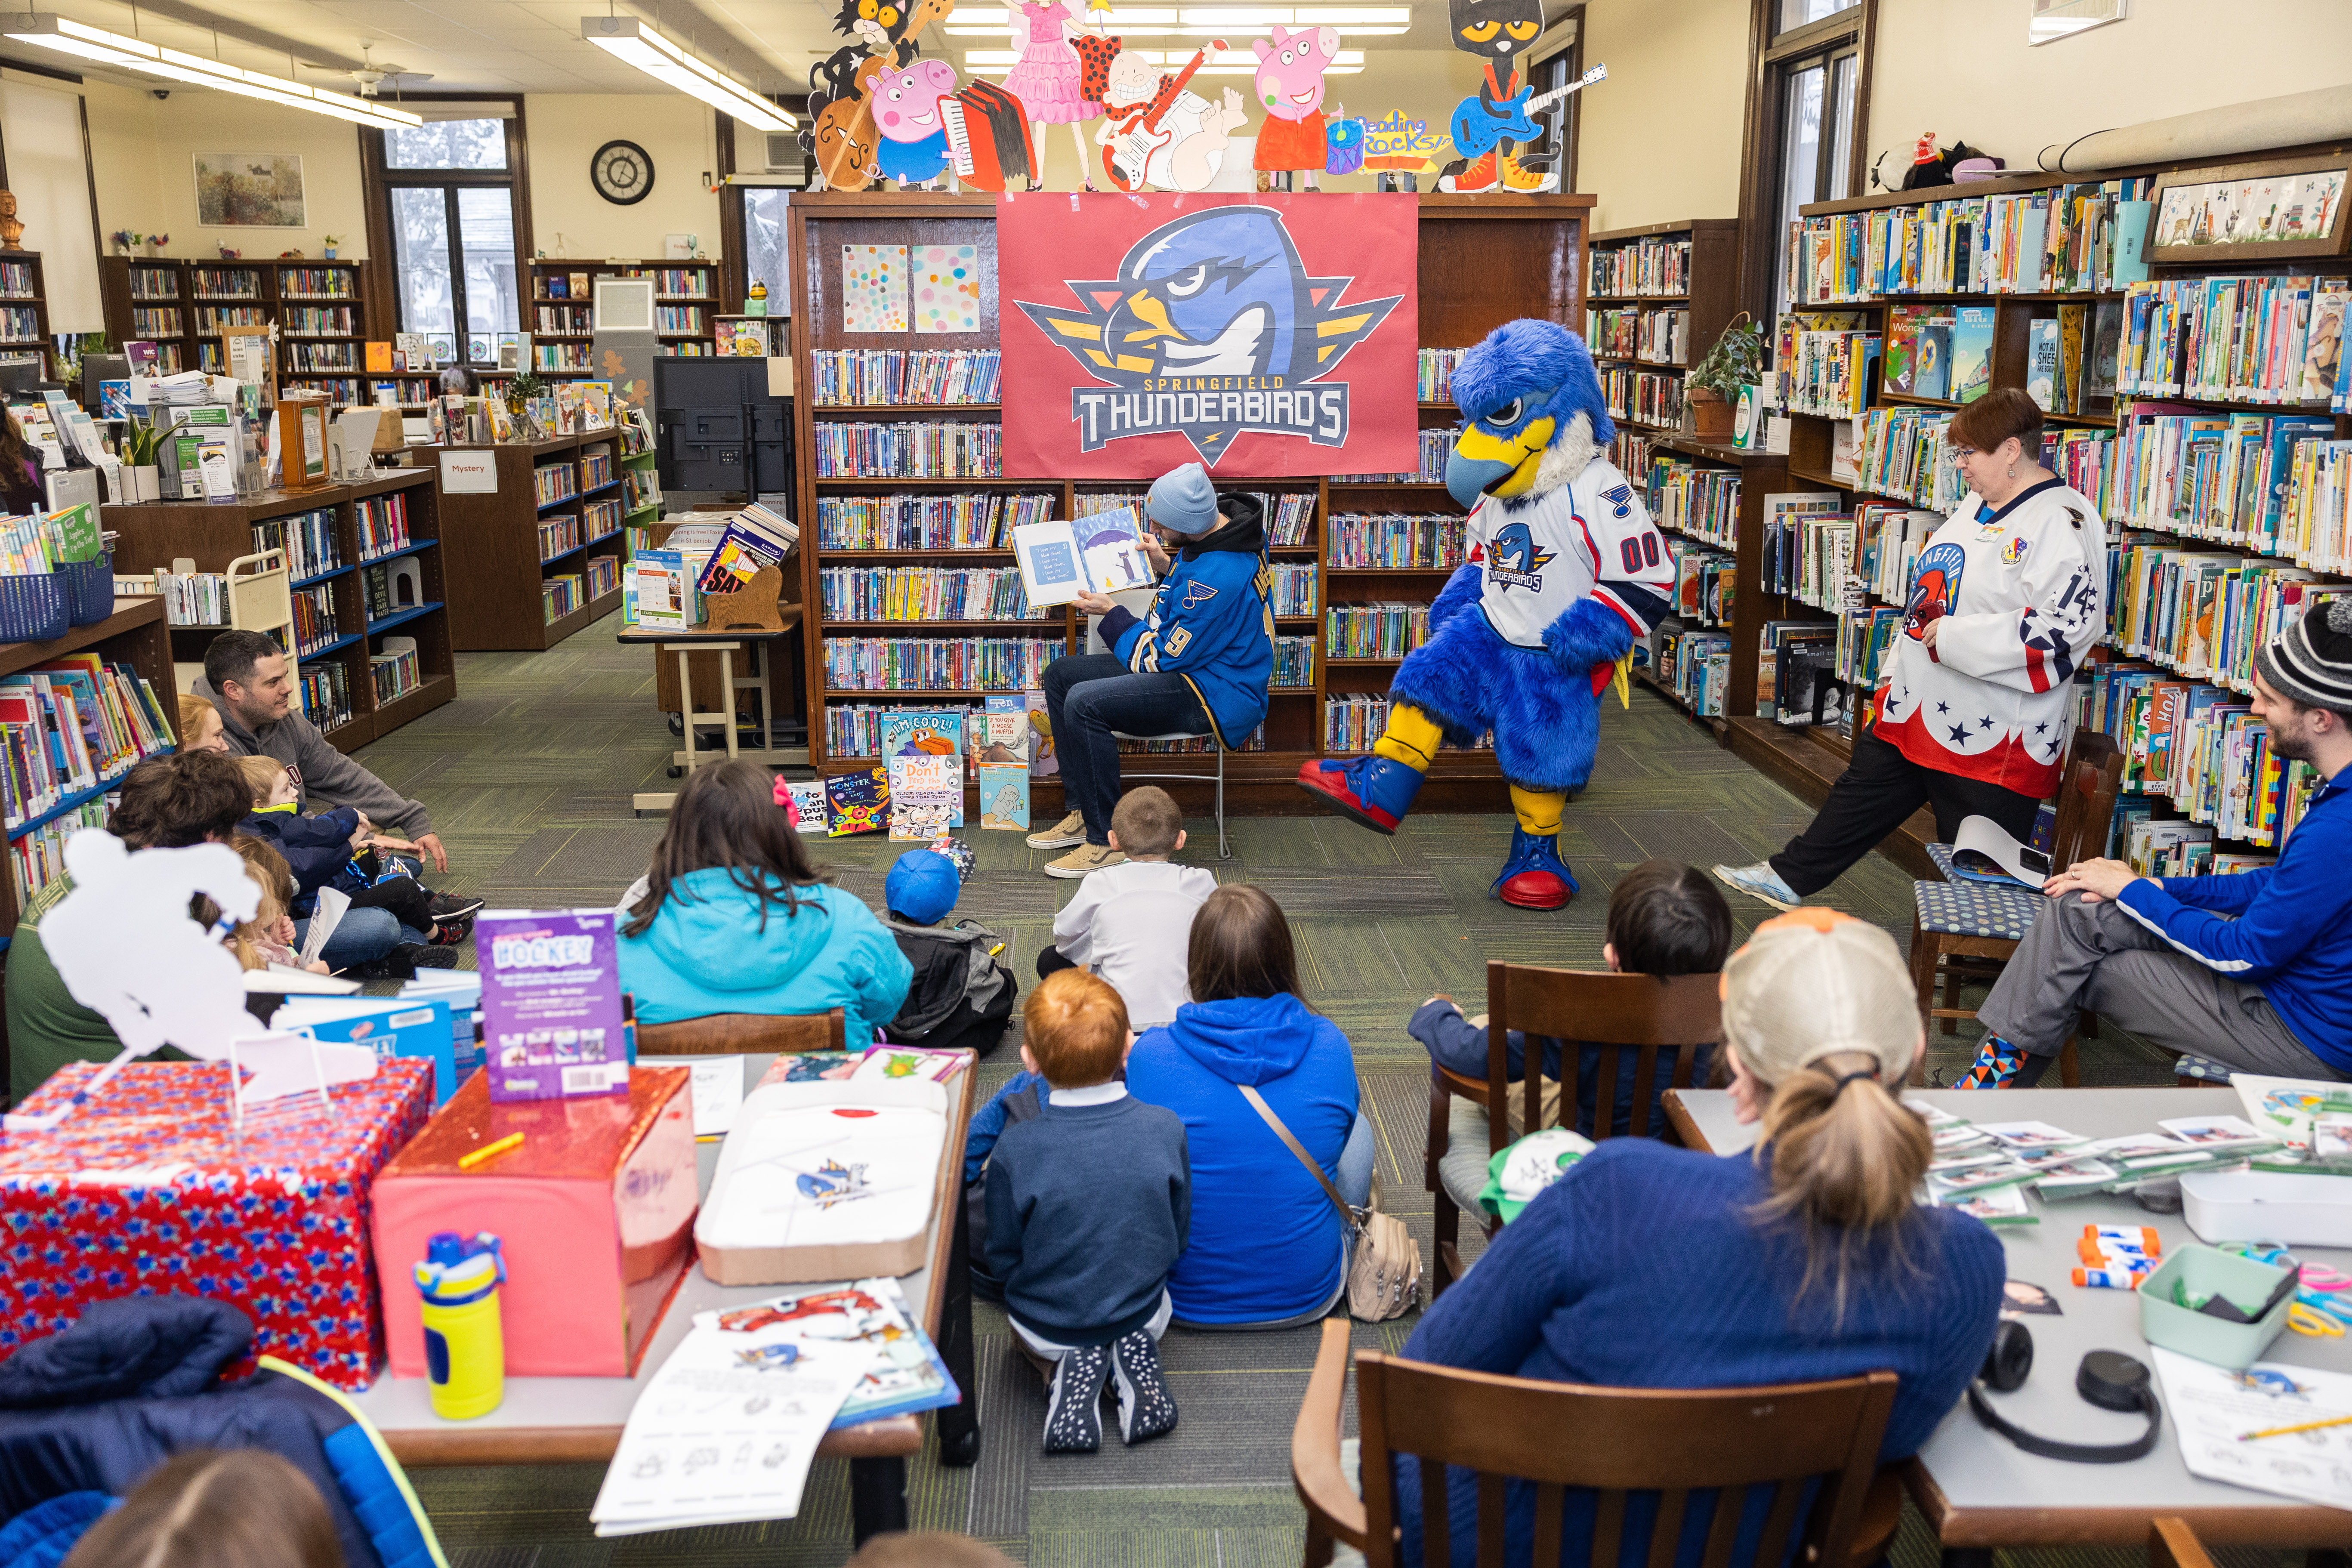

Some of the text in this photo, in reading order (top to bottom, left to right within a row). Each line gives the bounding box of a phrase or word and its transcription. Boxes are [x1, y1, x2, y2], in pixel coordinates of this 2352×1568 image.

[1354, 110, 1428, 134] Reading
[2039, 343, 2050, 351] NOT
[1144, 377, 1284, 391] SPRINGFIELD
[1079, 390, 1341, 443] THUNDERBIRDS
[719, 542, 739, 565] UP
[762, 543, 778, 555] KAPLAN
[1620, 531, 1659, 574] 00
[736, 553, 759, 574] YOUR
[1494, 566, 1525, 574] SPRINGFIELD
[1488, 570, 1540, 590] THUNDERBIRDS
[375, 590, 386, 599] DEVIL
[2056, 575, 2090, 618] 14
[376, 608, 389, 617] WATER
[377, 602, 387, 610] DARK
[995, 698, 1013, 708] Ten
[913, 716, 954, 733] COOL!
[905, 762, 940, 776] Don't
[829, 778, 871, 790] MONSTER
[799, 813, 823, 822] Bed
[497, 939, 590, 964] HOCKEY
